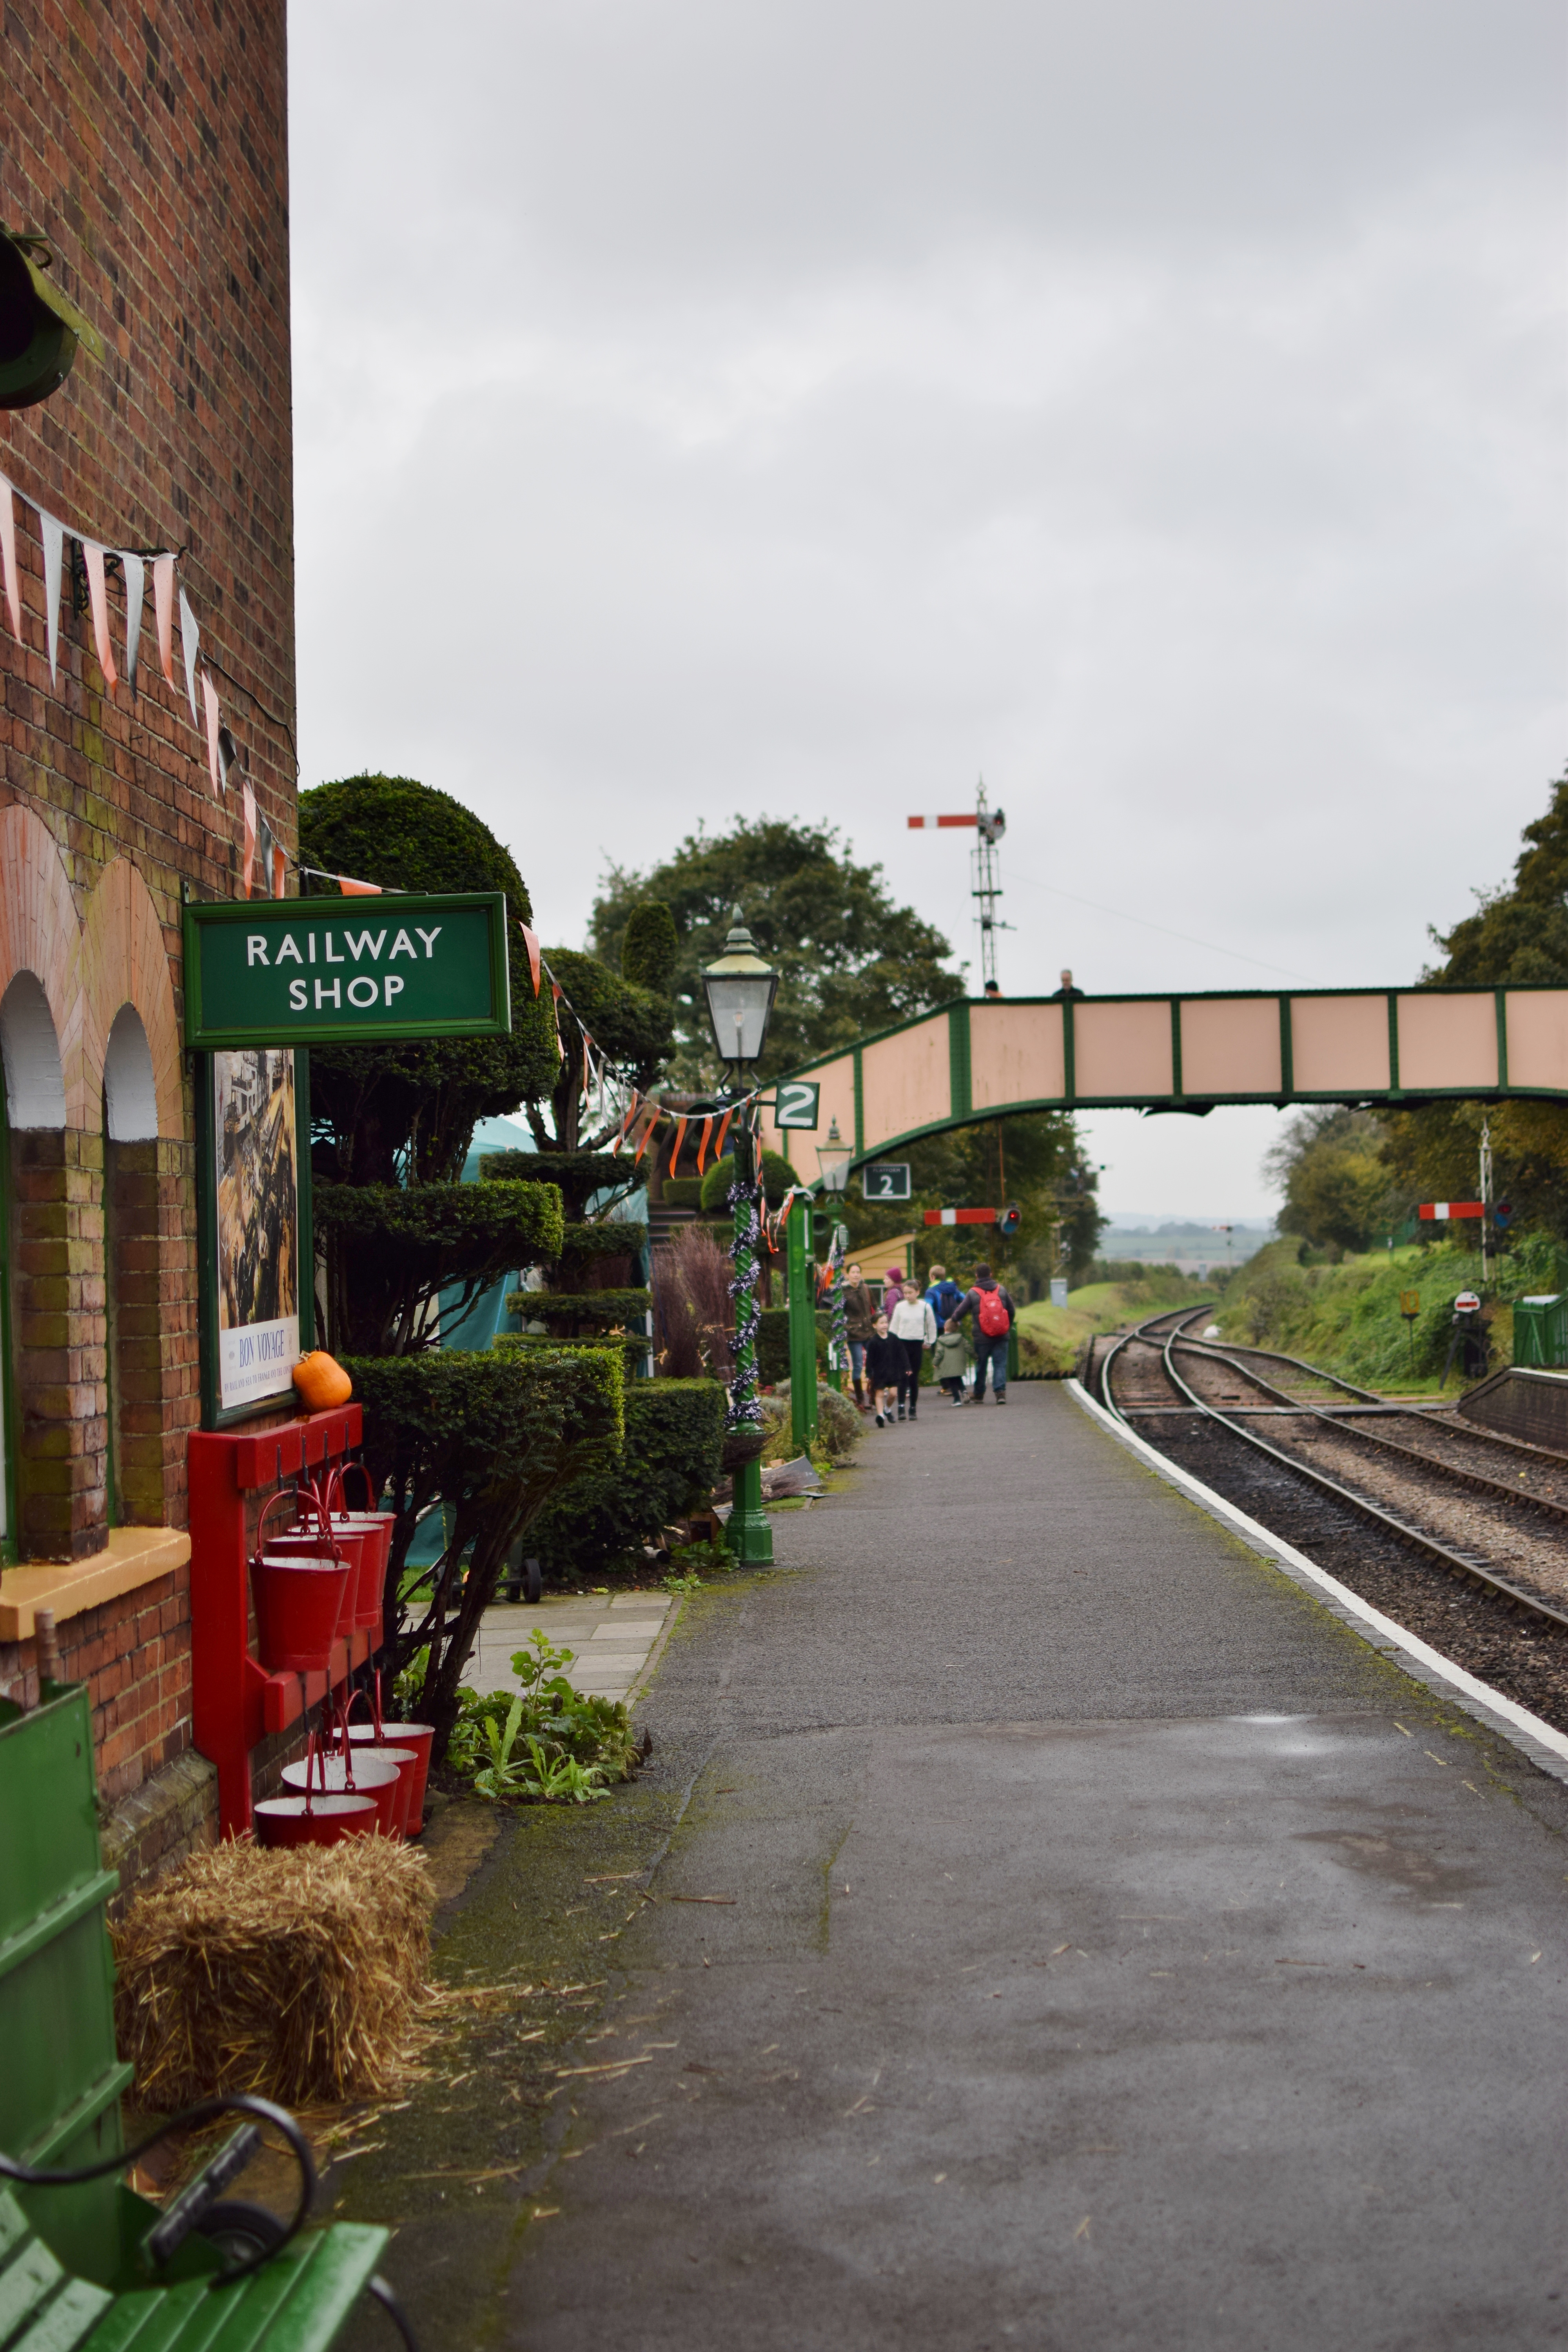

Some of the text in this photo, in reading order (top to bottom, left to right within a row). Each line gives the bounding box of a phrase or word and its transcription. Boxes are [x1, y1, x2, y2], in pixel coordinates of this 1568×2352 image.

[247, 927, 442, 966] RAILWAY
[289, 976, 404, 1011] SHOP
[778, 1085, 815, 1126] 2
[880, 1175, 893, 1194] 2
[1400, 1290, 1419, 1314] 10
[240, 1330, 284, 1368] BON VOYAGE
[225, 1383, 229, 1392] BY
[252, 1374, 257, 1384] TO
[258, 1371, 270, 1382] FRANCE
[283, 1364, 295, 1375] CONTIN
